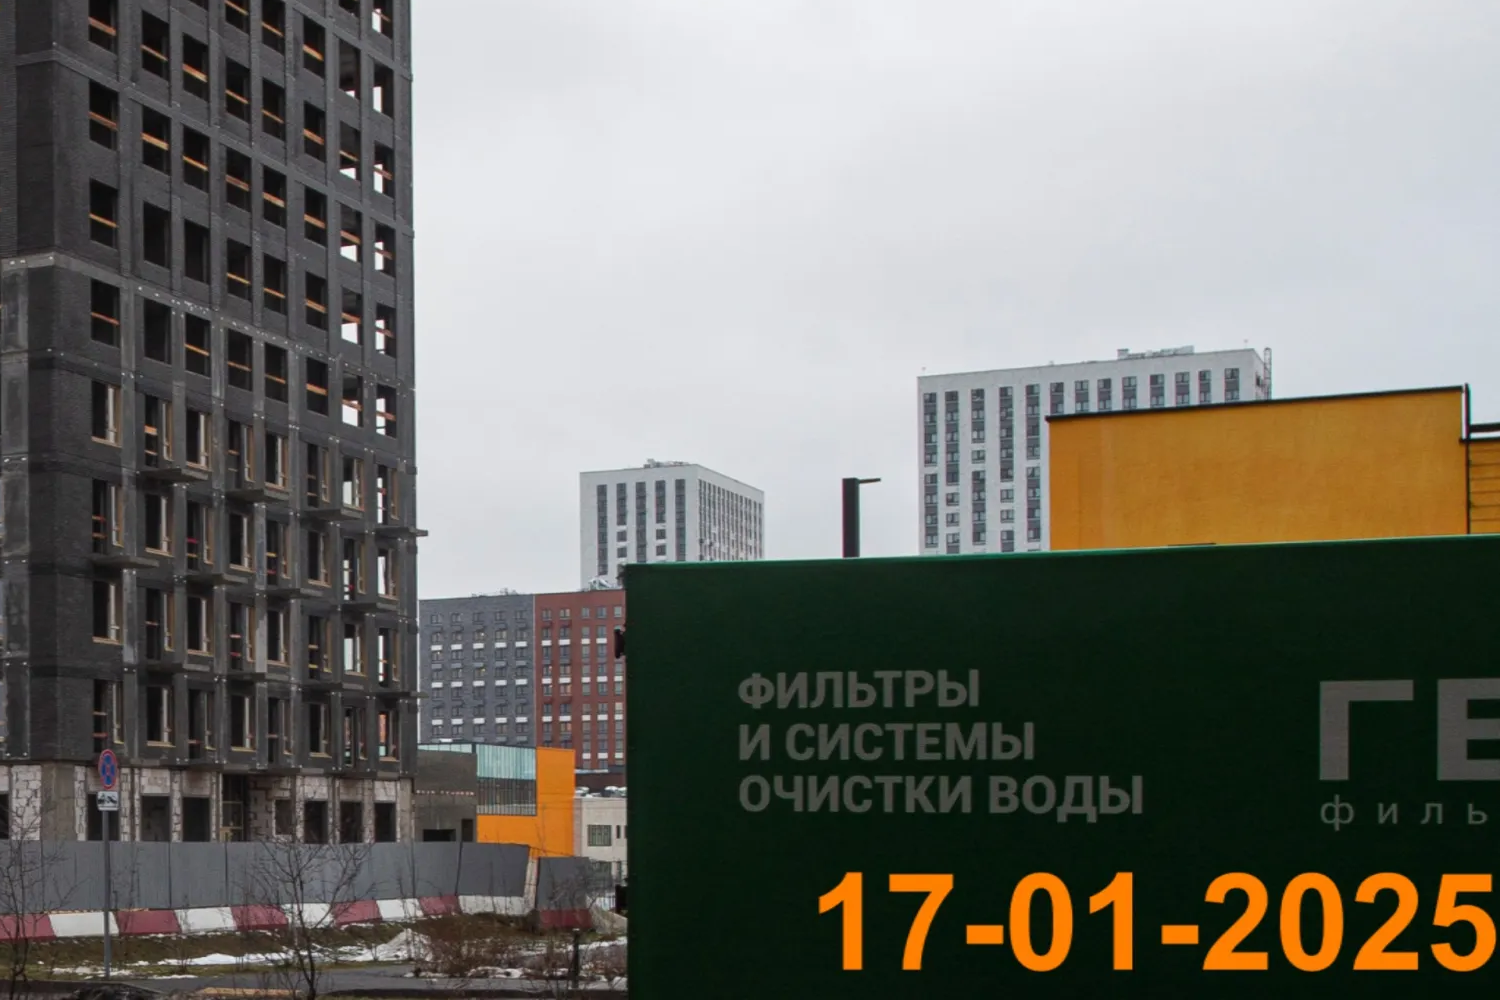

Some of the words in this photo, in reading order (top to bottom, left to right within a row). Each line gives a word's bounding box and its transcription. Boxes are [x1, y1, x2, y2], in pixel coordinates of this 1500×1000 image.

[738, 668, 980, 710] ФИЛЬТРЫ
[739, 723, 771, 761] И
[785, 721, 1035, 762] СИСТЕМЫ
[739, 774, 972, 814] ОЧИСТКИ
[989, 775, 1143, 824] ВОДЫ
[1320, 794, 1488, 832] филь
